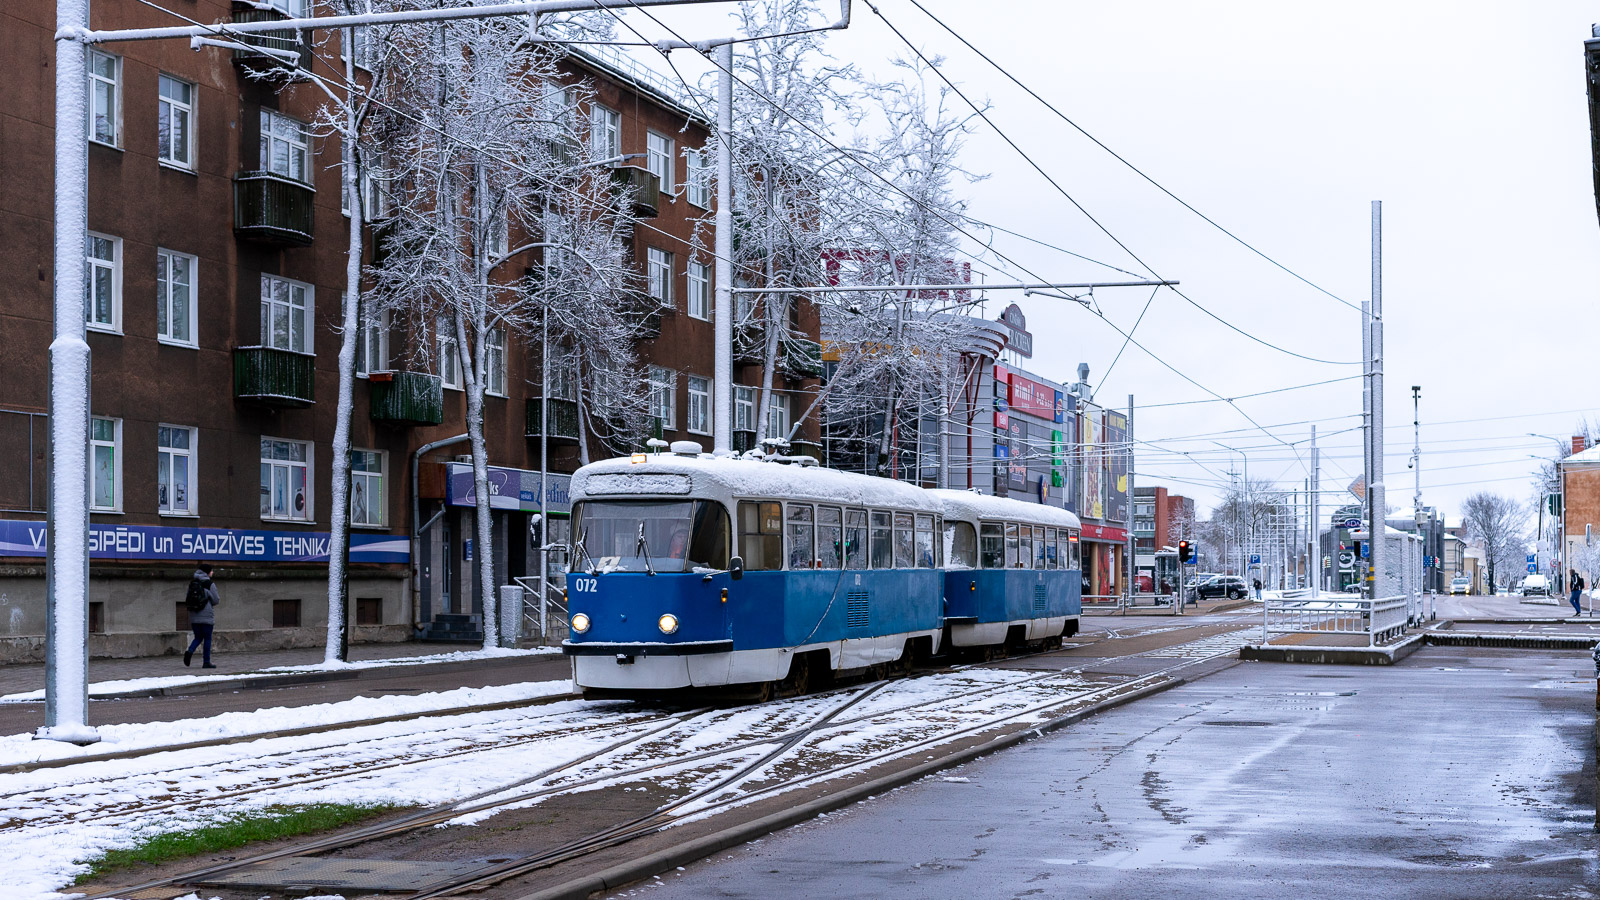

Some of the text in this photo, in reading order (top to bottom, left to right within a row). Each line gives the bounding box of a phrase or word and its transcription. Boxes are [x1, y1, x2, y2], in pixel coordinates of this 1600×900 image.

[28, 527, 146, 553] VSIPĒDI
[153, 536, 174, 554] un
[181, 531, 265, 555] SADZĪVES
[1252, 555, 1258, 563] P
[575, 578, 598, 593] 072
